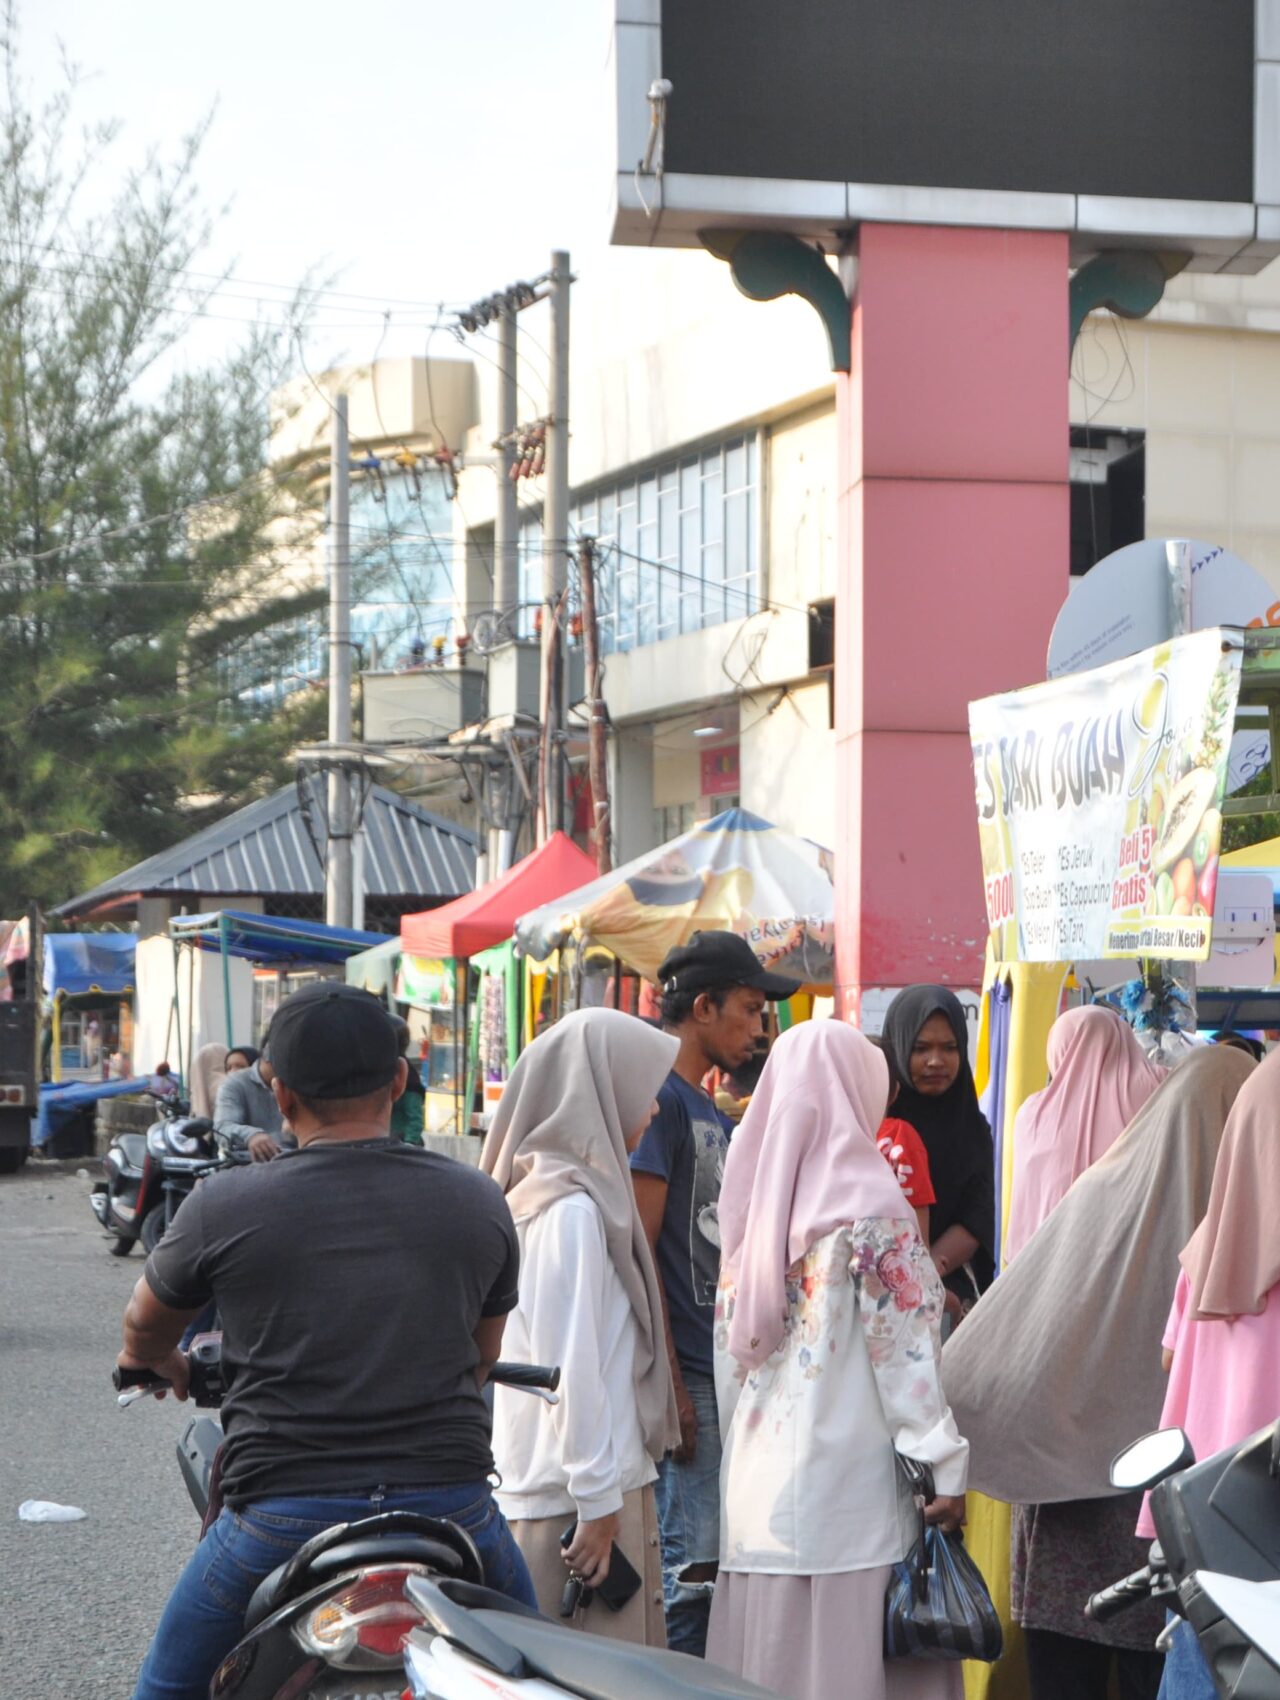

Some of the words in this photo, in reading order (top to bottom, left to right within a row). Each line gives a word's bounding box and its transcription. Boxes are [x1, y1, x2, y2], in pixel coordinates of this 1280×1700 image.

[1051, 709, 1126, 810] BUAH
[1119, 832, 1139, 867] Beli
[1141, 827, 1152, 861] 5
[1111, 875, 1147, 911] Gratis
